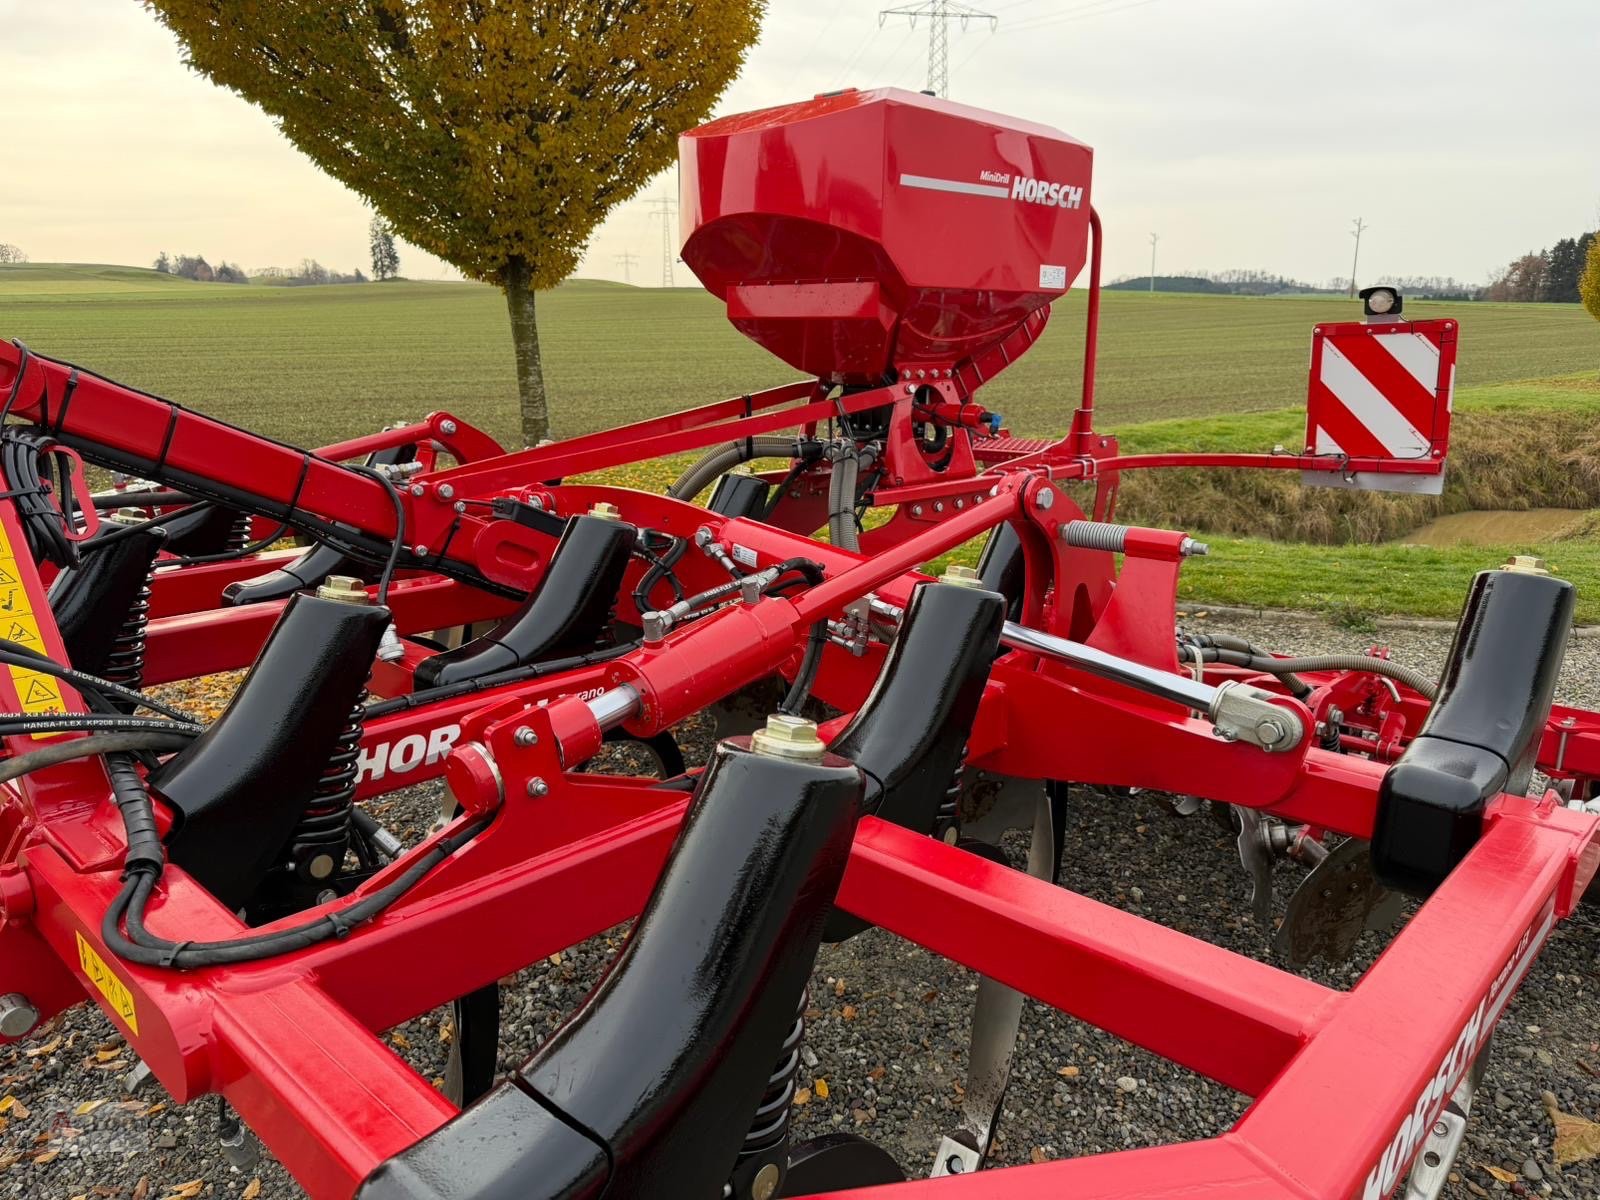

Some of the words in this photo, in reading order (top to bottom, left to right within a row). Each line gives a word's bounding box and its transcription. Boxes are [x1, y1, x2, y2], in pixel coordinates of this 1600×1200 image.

[980, 170, 1010, 184] MiniDrill
[1012, 175, 1083, 210] HORSCH
[23, 720, 82, 730] HANSA-FLEX
[117, 719, 130, 727] EN
[1362, 995, 1487, 1200] HORSCH
